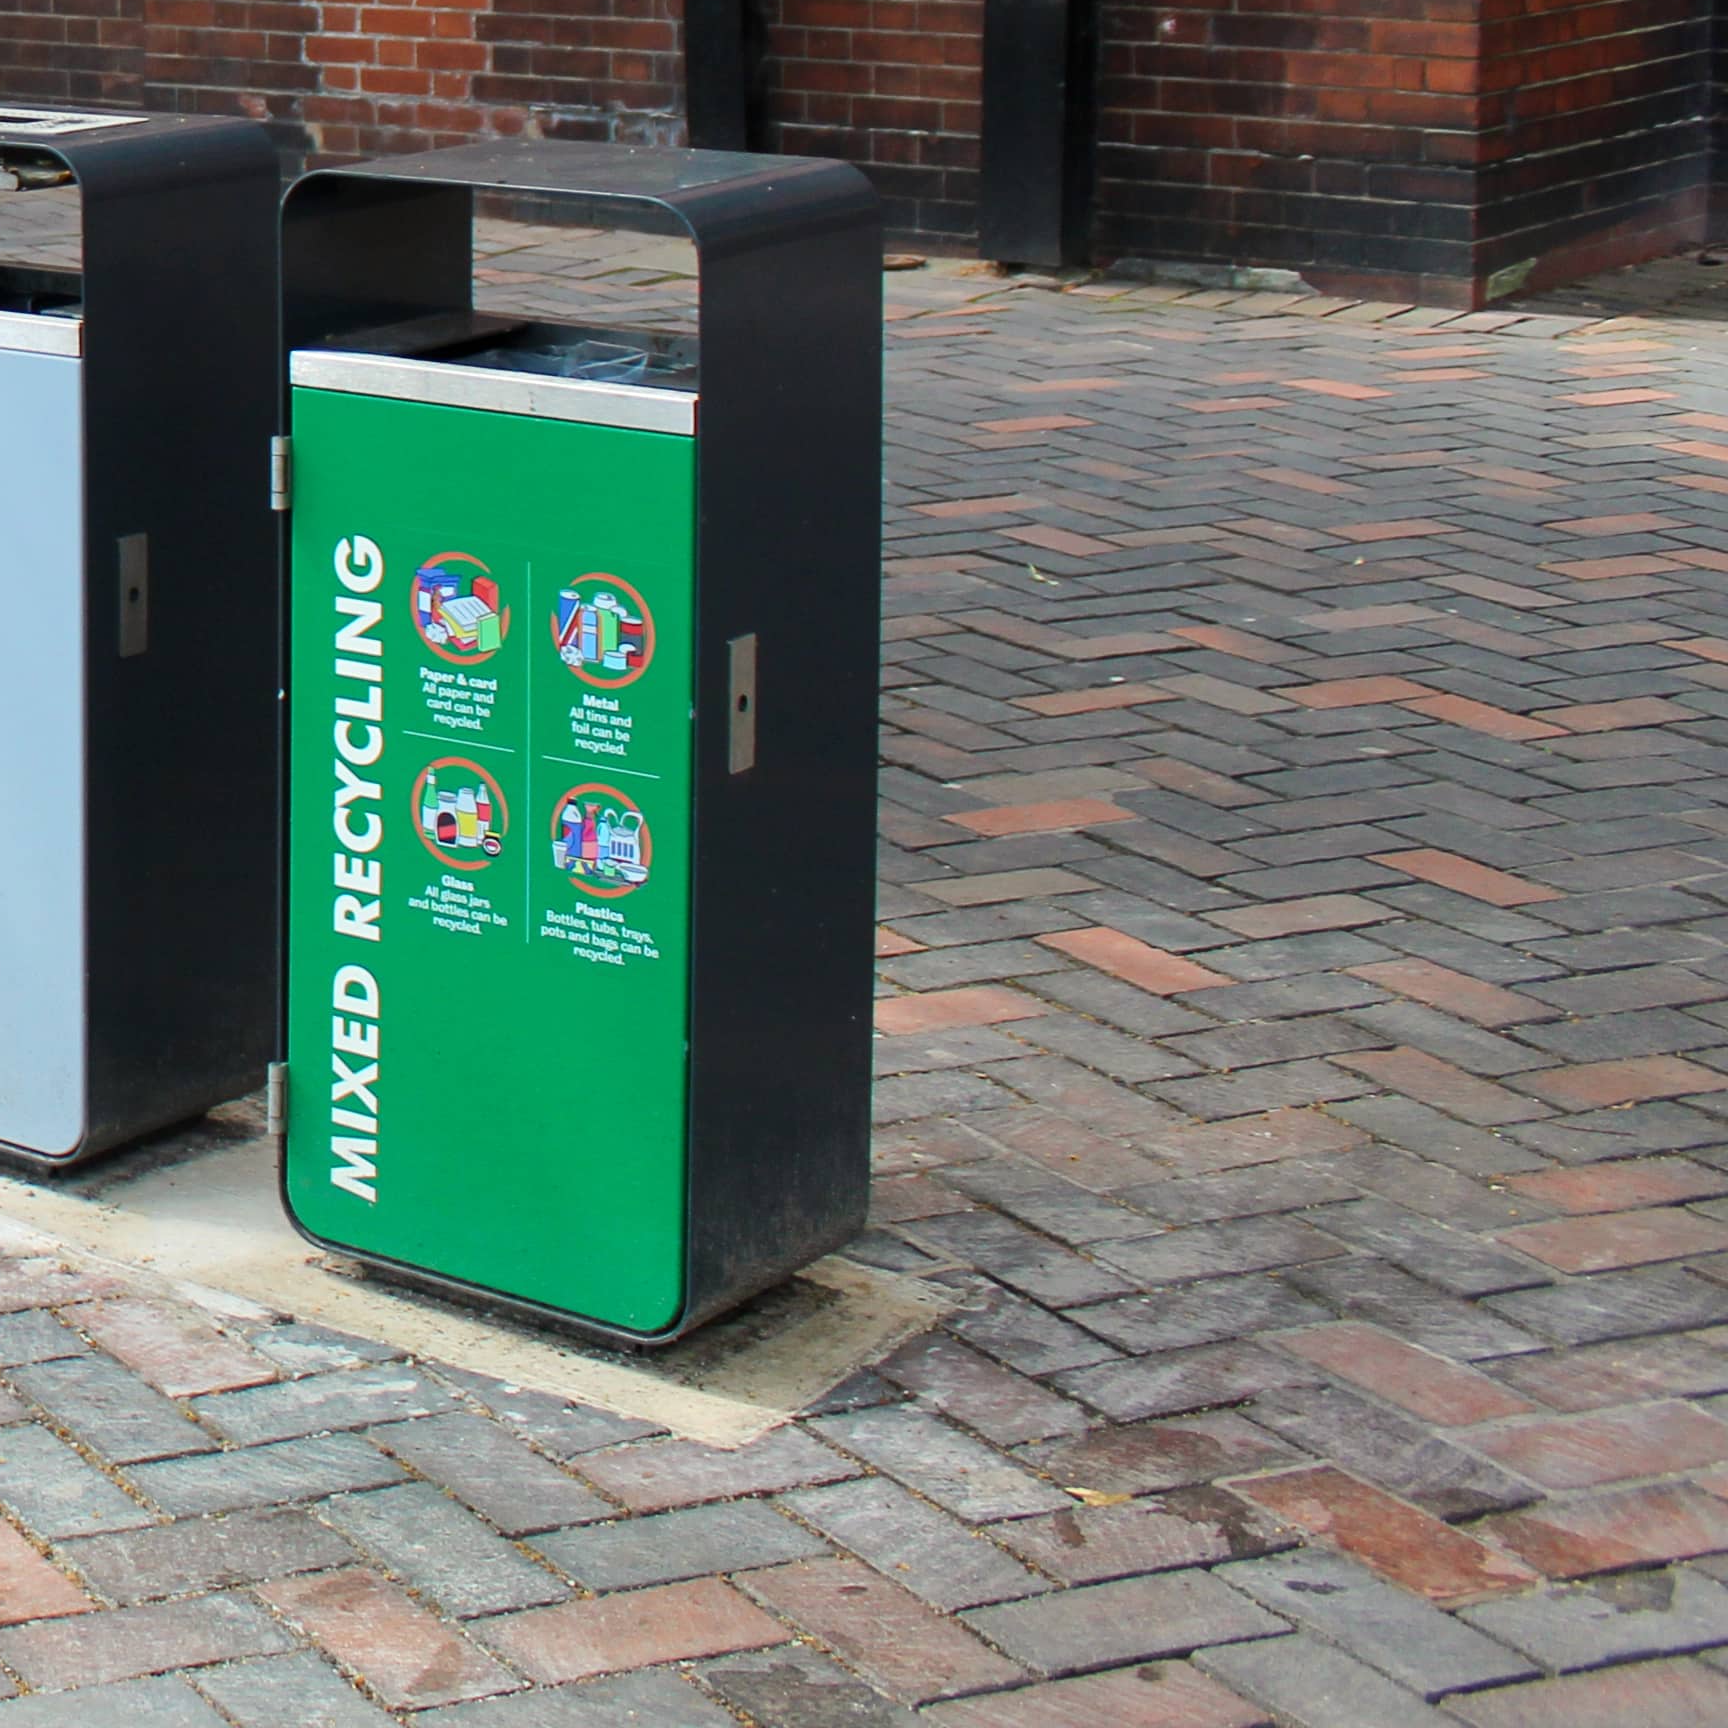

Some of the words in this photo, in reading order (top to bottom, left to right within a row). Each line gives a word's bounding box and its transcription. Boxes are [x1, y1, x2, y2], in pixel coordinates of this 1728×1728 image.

[419, 666, 455, 683] Paper
[456, 673, 467, 686] &
[468, 678, 498, 691] card
[422, 681, 437, 694] All
[438, 686, 472, 700] paper
[473, 693, 495, 704] and
[582, 693, 619, 711] Metal
[426, 698, 452, 711] card
[453, 703, 474, 714] can
[475, 704, 491, 717] be
[569, 706, 584, 720] All
[586, 710, 608, 724] tins
[609, 716, 632, 728] and
[433, 713, 483, 731] recycled.
[571, 720, 590, 734] foil
[591, 727, 613, 739] can
[614, 728, 631, 742] be
[333, 532, 386, 943] RECYCLING
[574, 738, 627, 756] recycled.
[441, 874, 475, 892] Glass
[424, 885, 439, 899] All
[440, 889, 468, 904] glass
[468, 893, 491, 909] jars
[408, 897, 429, 910] and
[430, 898, 470, 918] bottles
[470, 910, 491, 923] can
[492, 912, 508, 926] be
[575, 901, 625, 923] Plastics
[433, 916, 483, 935] recycled.
[567, 931, 590, 944] and
[591, 933, 619, 952] bags
[620, 942, 642, 955] can
[643, 943, 660, 959] be
[573, 946, 625, 966] recycled.
[330, 962, 381, 1203] MIXED
